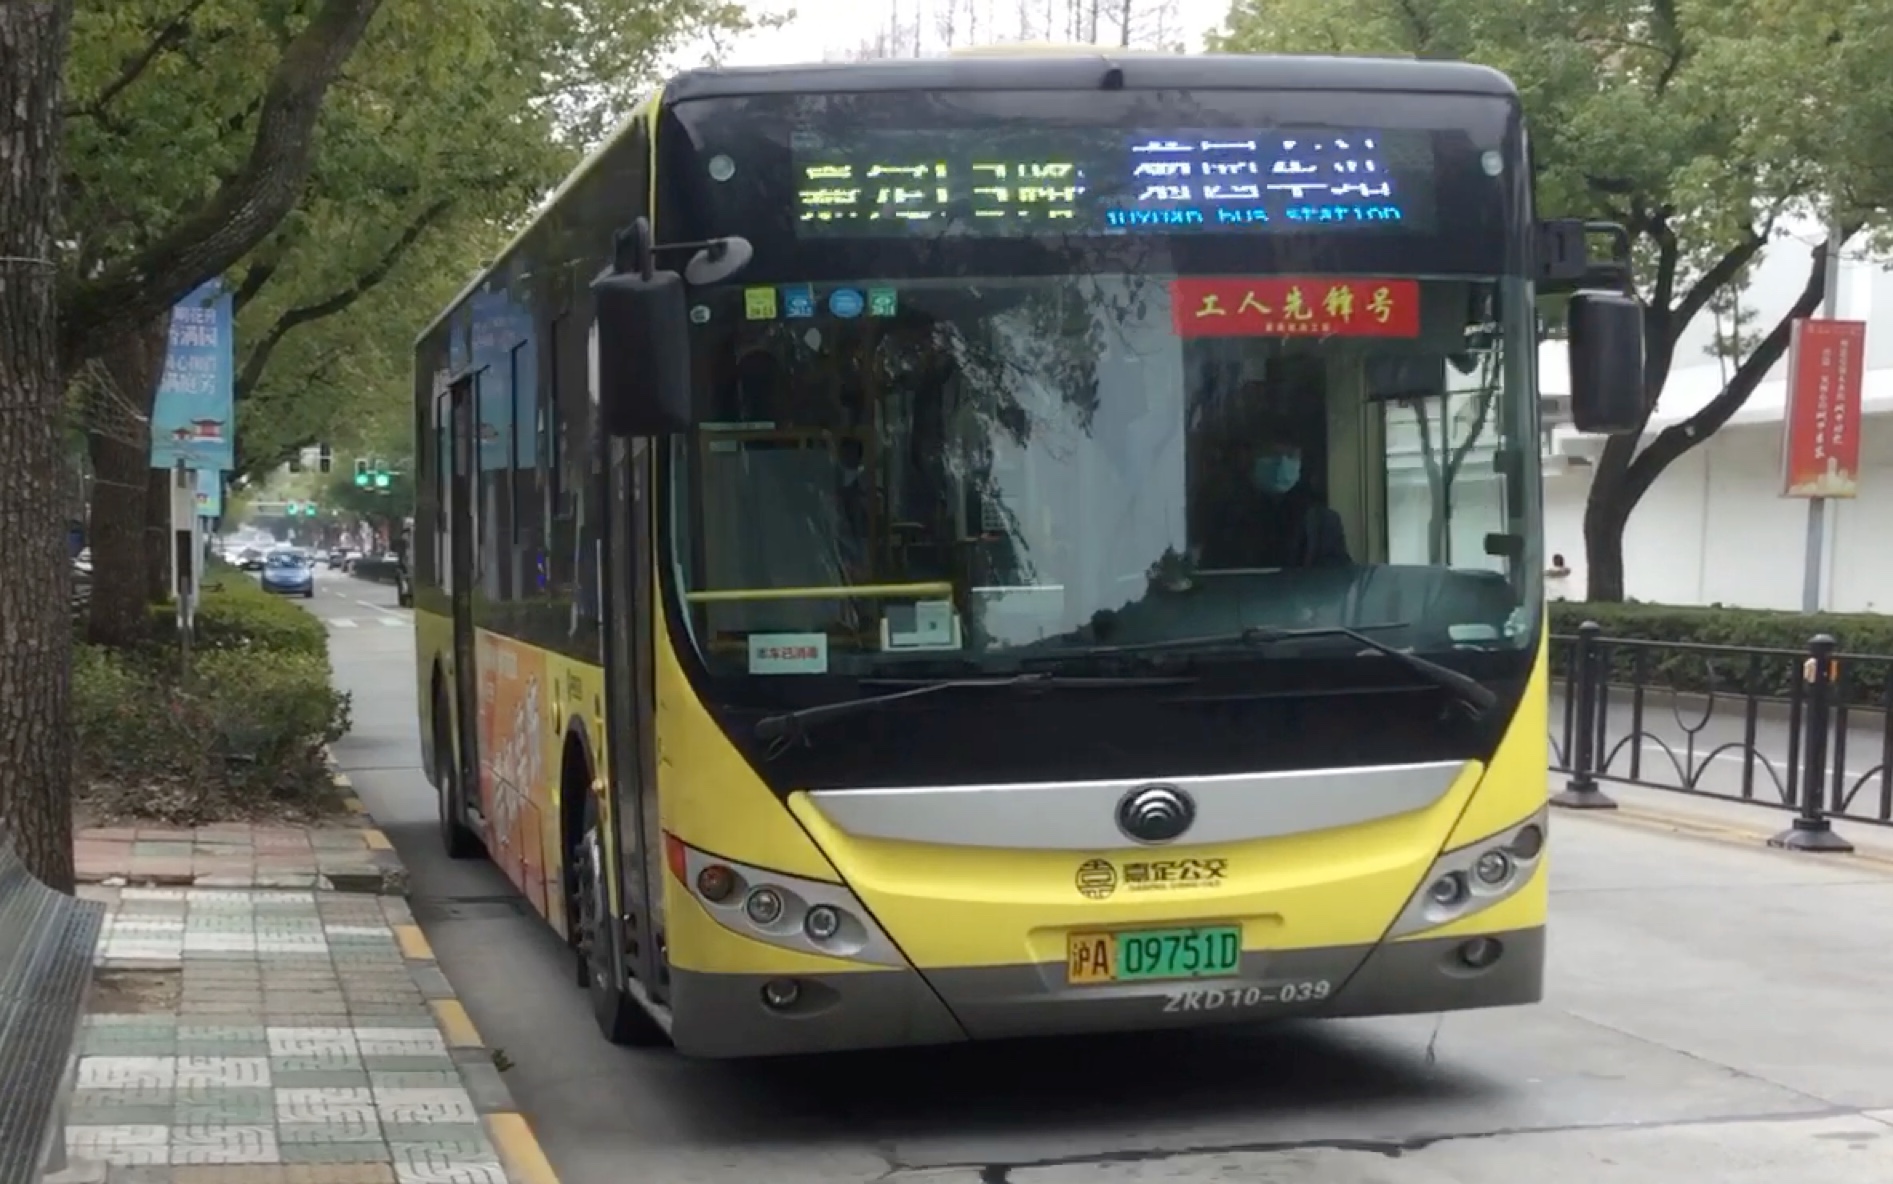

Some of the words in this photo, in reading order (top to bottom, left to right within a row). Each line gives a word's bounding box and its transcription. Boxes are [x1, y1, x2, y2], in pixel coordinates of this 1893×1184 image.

[1196, 285, 1393, 323] 工人先锋号
[1125, 932, 1238, 974] 09751D
[1163, 980, 1331, 1012] ZKD10-039
